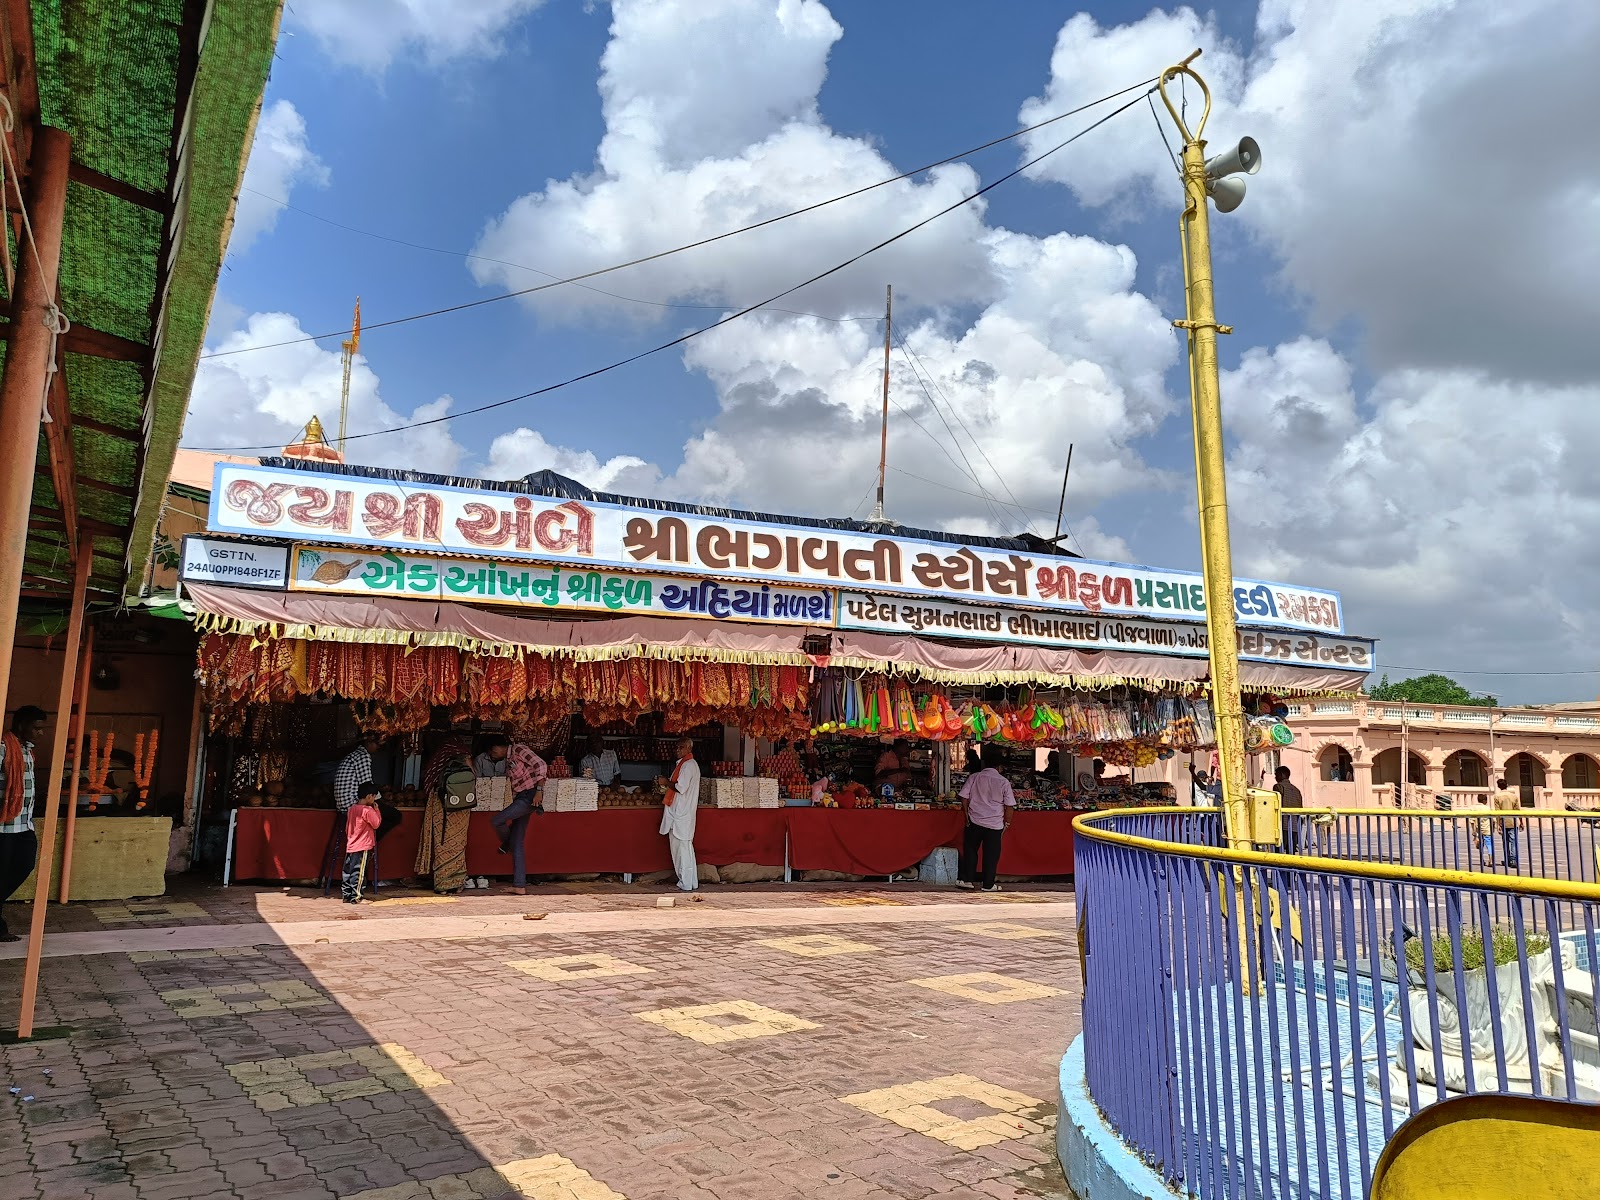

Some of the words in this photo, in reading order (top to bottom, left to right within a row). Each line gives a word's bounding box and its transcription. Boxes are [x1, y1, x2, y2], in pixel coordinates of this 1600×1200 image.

[209, 548, 257, 562] GSTIN.
[224, 479, 355, 534] જય
[361, 492, 443, 542] શ્રી
[455, 495, 596, 557] અંબે
[622, 516, 690, 564] શ્રી
[696, 524, 904, 586] ભગવતી
[1035, 565, 1134, 613] શ્રીફળ
[186, 562, 281, 579] 24AUOPP1848F1ZF
[360, 551, 438, 592] એક
[443, 561, 561, 606] આંખનું
[566, 571, 653, 610] શ્રીફળ
[659, 579, 772, 619] અહિયાં
[773, 589, 833, 620] મળશે
[847, 594, 898, 623] પટેલ
